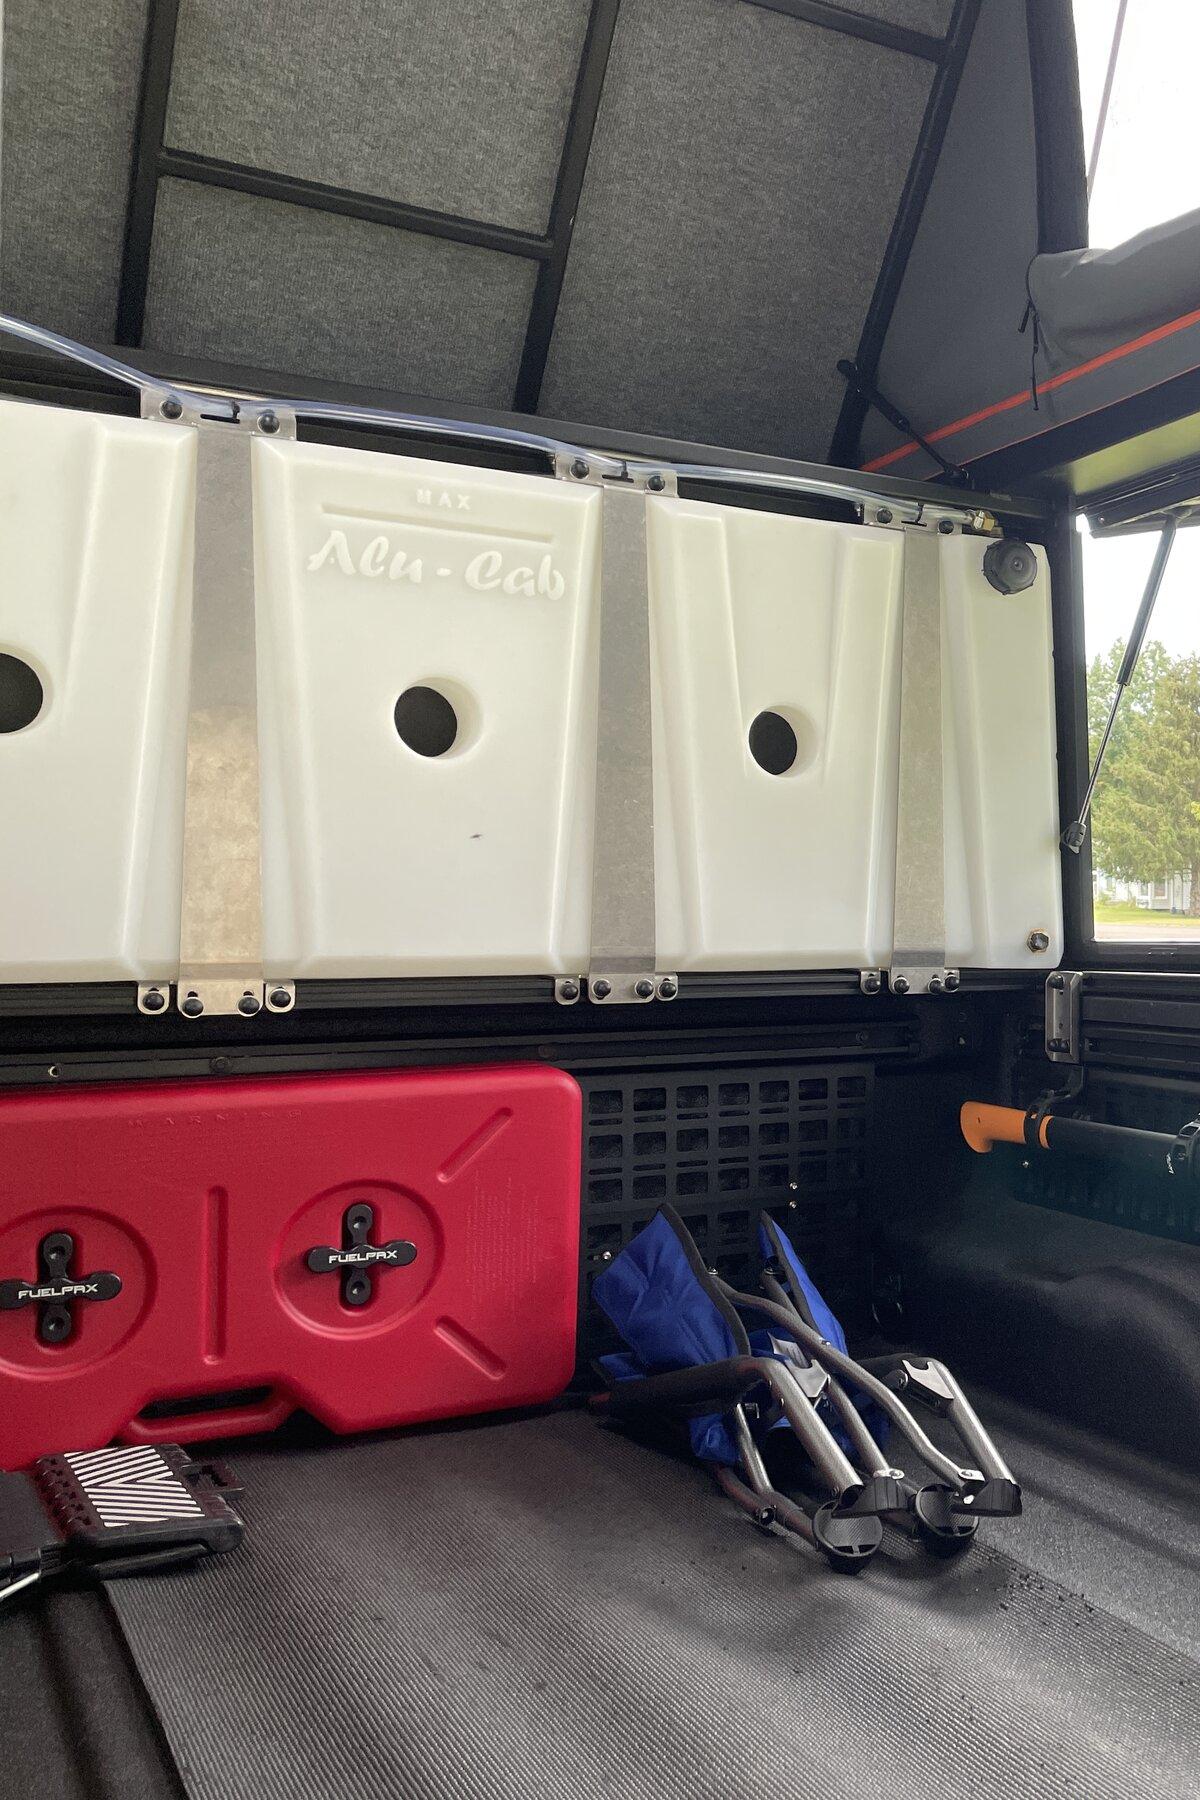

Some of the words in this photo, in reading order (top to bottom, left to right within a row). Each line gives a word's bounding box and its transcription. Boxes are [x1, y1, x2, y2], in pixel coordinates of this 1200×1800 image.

[416, 488, 471, 511] MAX
[329, 1250, 397, 1264] FUELPAX
[17, 1283, 98, 1300] FUELPAX
